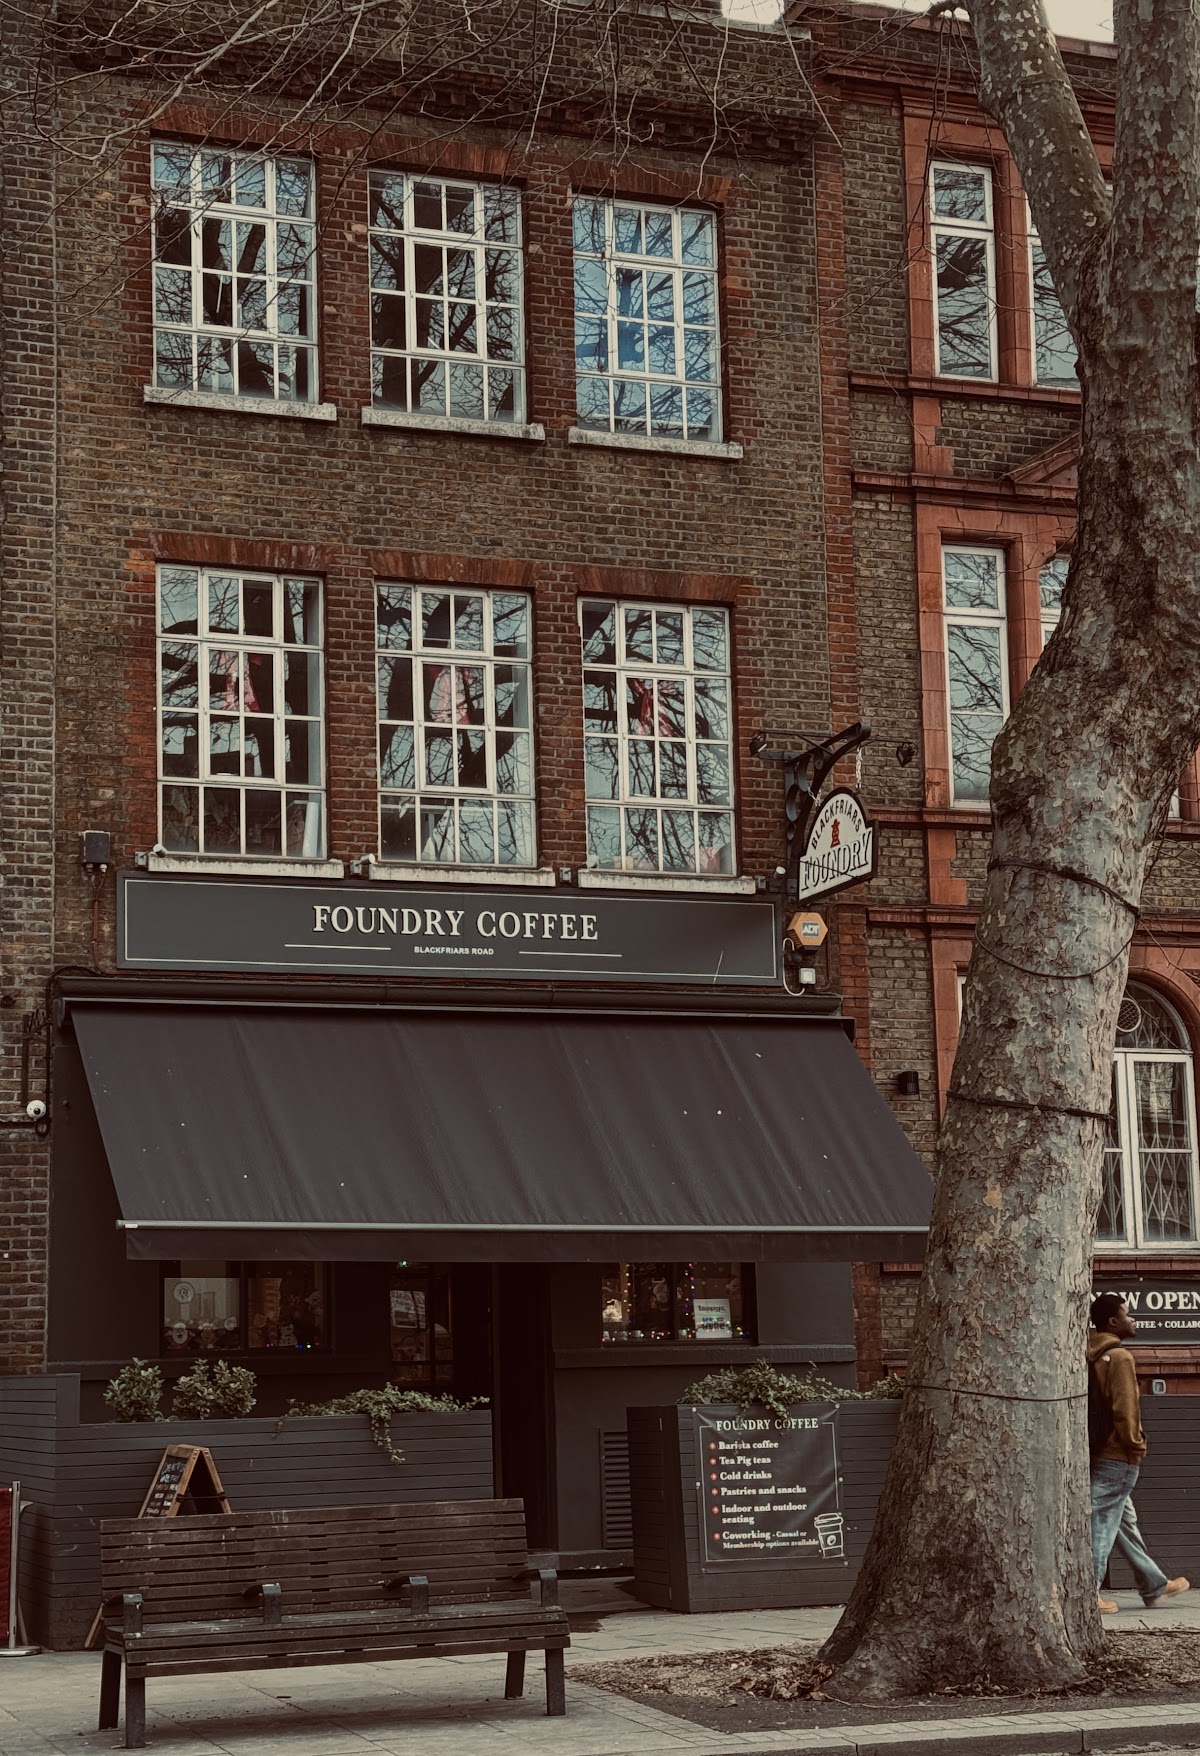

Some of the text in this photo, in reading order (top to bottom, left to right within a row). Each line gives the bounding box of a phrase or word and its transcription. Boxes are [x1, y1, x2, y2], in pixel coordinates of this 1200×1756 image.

[811, 799, 863, 850] BLACKFRIARS
[801, 830, 872, 891] FOUNDRY
[312, 905, 599, 941] FOUNDRY COFFEE
[802, 924, 820, 934] ADT
[414, 946, 494, 956] BLACKFRIARS ROAD
[1135, 1320, 1157, 1329] FFEE
[752, 1440, 779, 1449] coffee
[719, 1455, 771, 1467] Tea Pig teas
[720, 1471, 772, 1481] Cold drinks
[720, 1485, 807, 1496] Pastries and snacks
[721, 1502, 807, 1513] Indoor and outdoor
[722, 1514, 755, 1525] seating
[722, 1530, 771, 1540] Coworking
[776, 1530, 799, 1538] Casual
[722, 1538, 819, 1549] Membership options available
